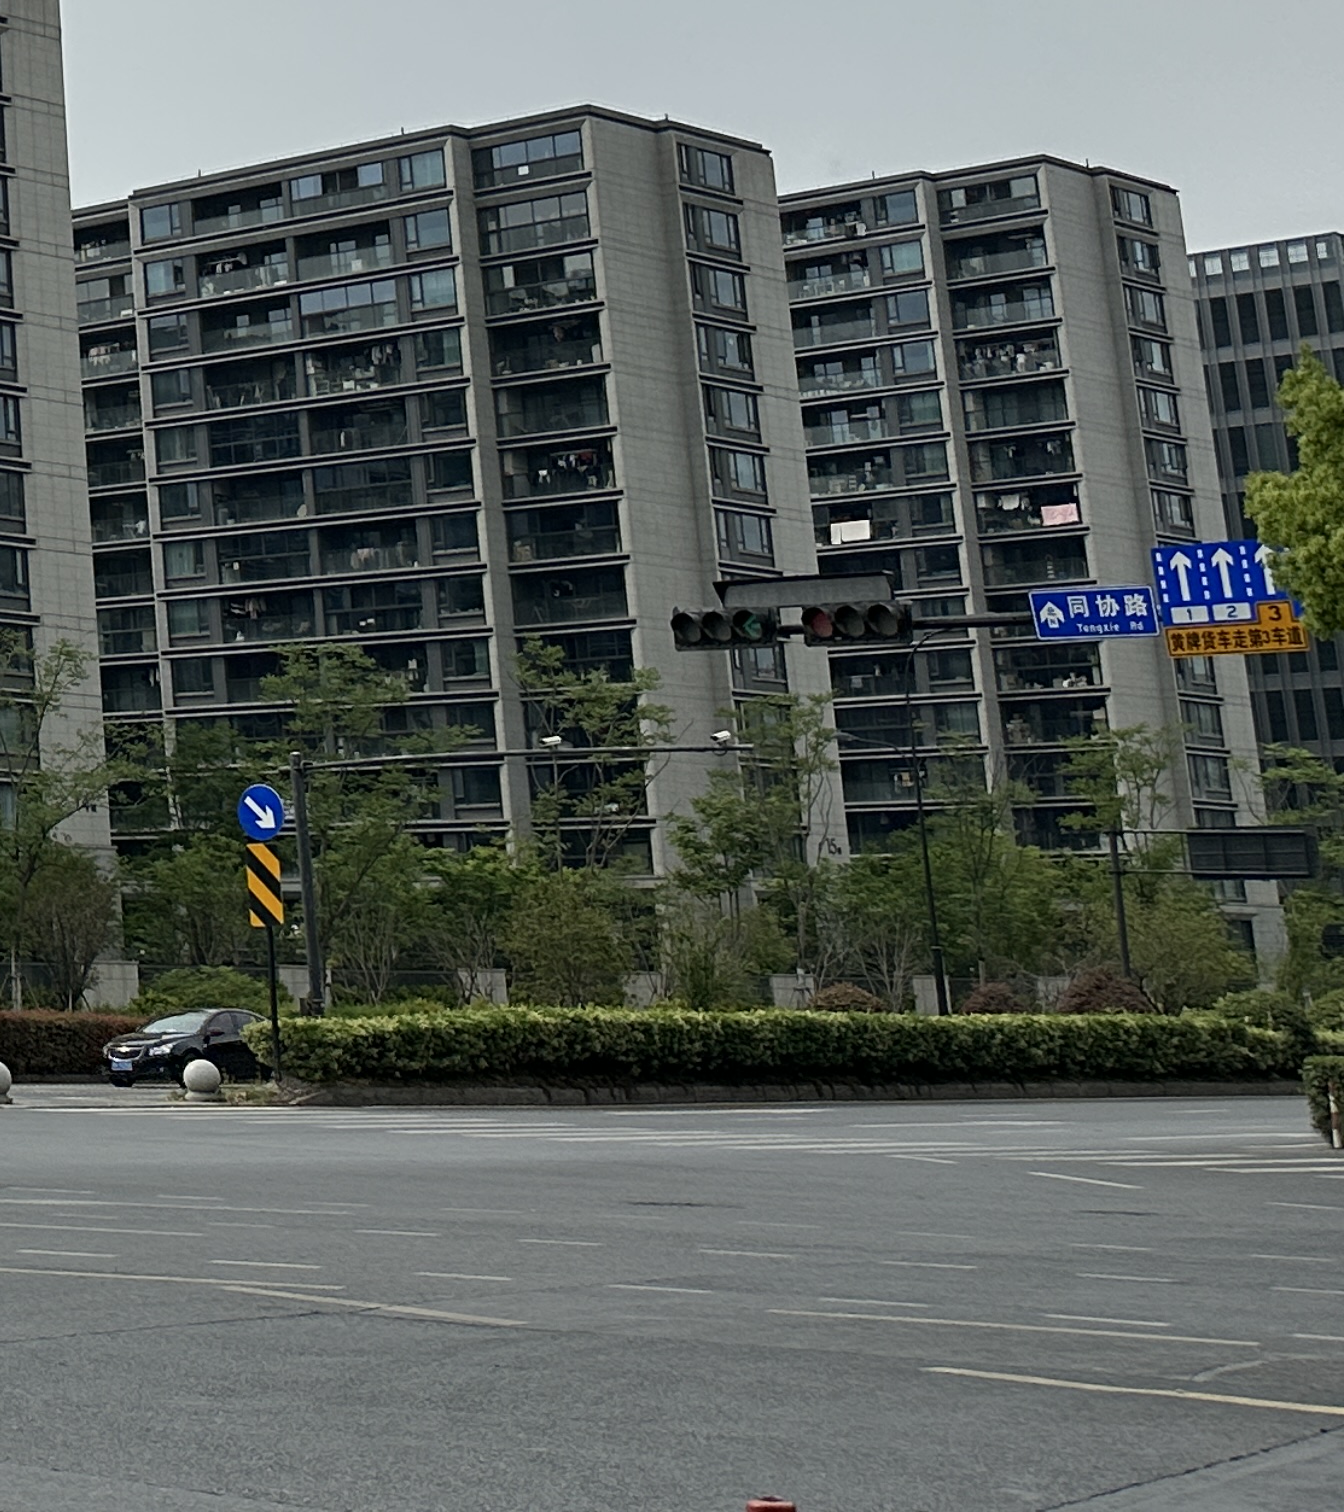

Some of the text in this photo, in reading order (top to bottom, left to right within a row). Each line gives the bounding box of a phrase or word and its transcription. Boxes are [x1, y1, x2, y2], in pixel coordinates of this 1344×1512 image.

[1067, 594, 1147, 618] 同协路
[1186, 605, 1238, 621] 1 2
[1267, 605, 1282, 621] 3
[1076, 621, 1144, 634] Tongxie Rd
[1170, 626, 1303, 652] 黄牌货车走第3车道
